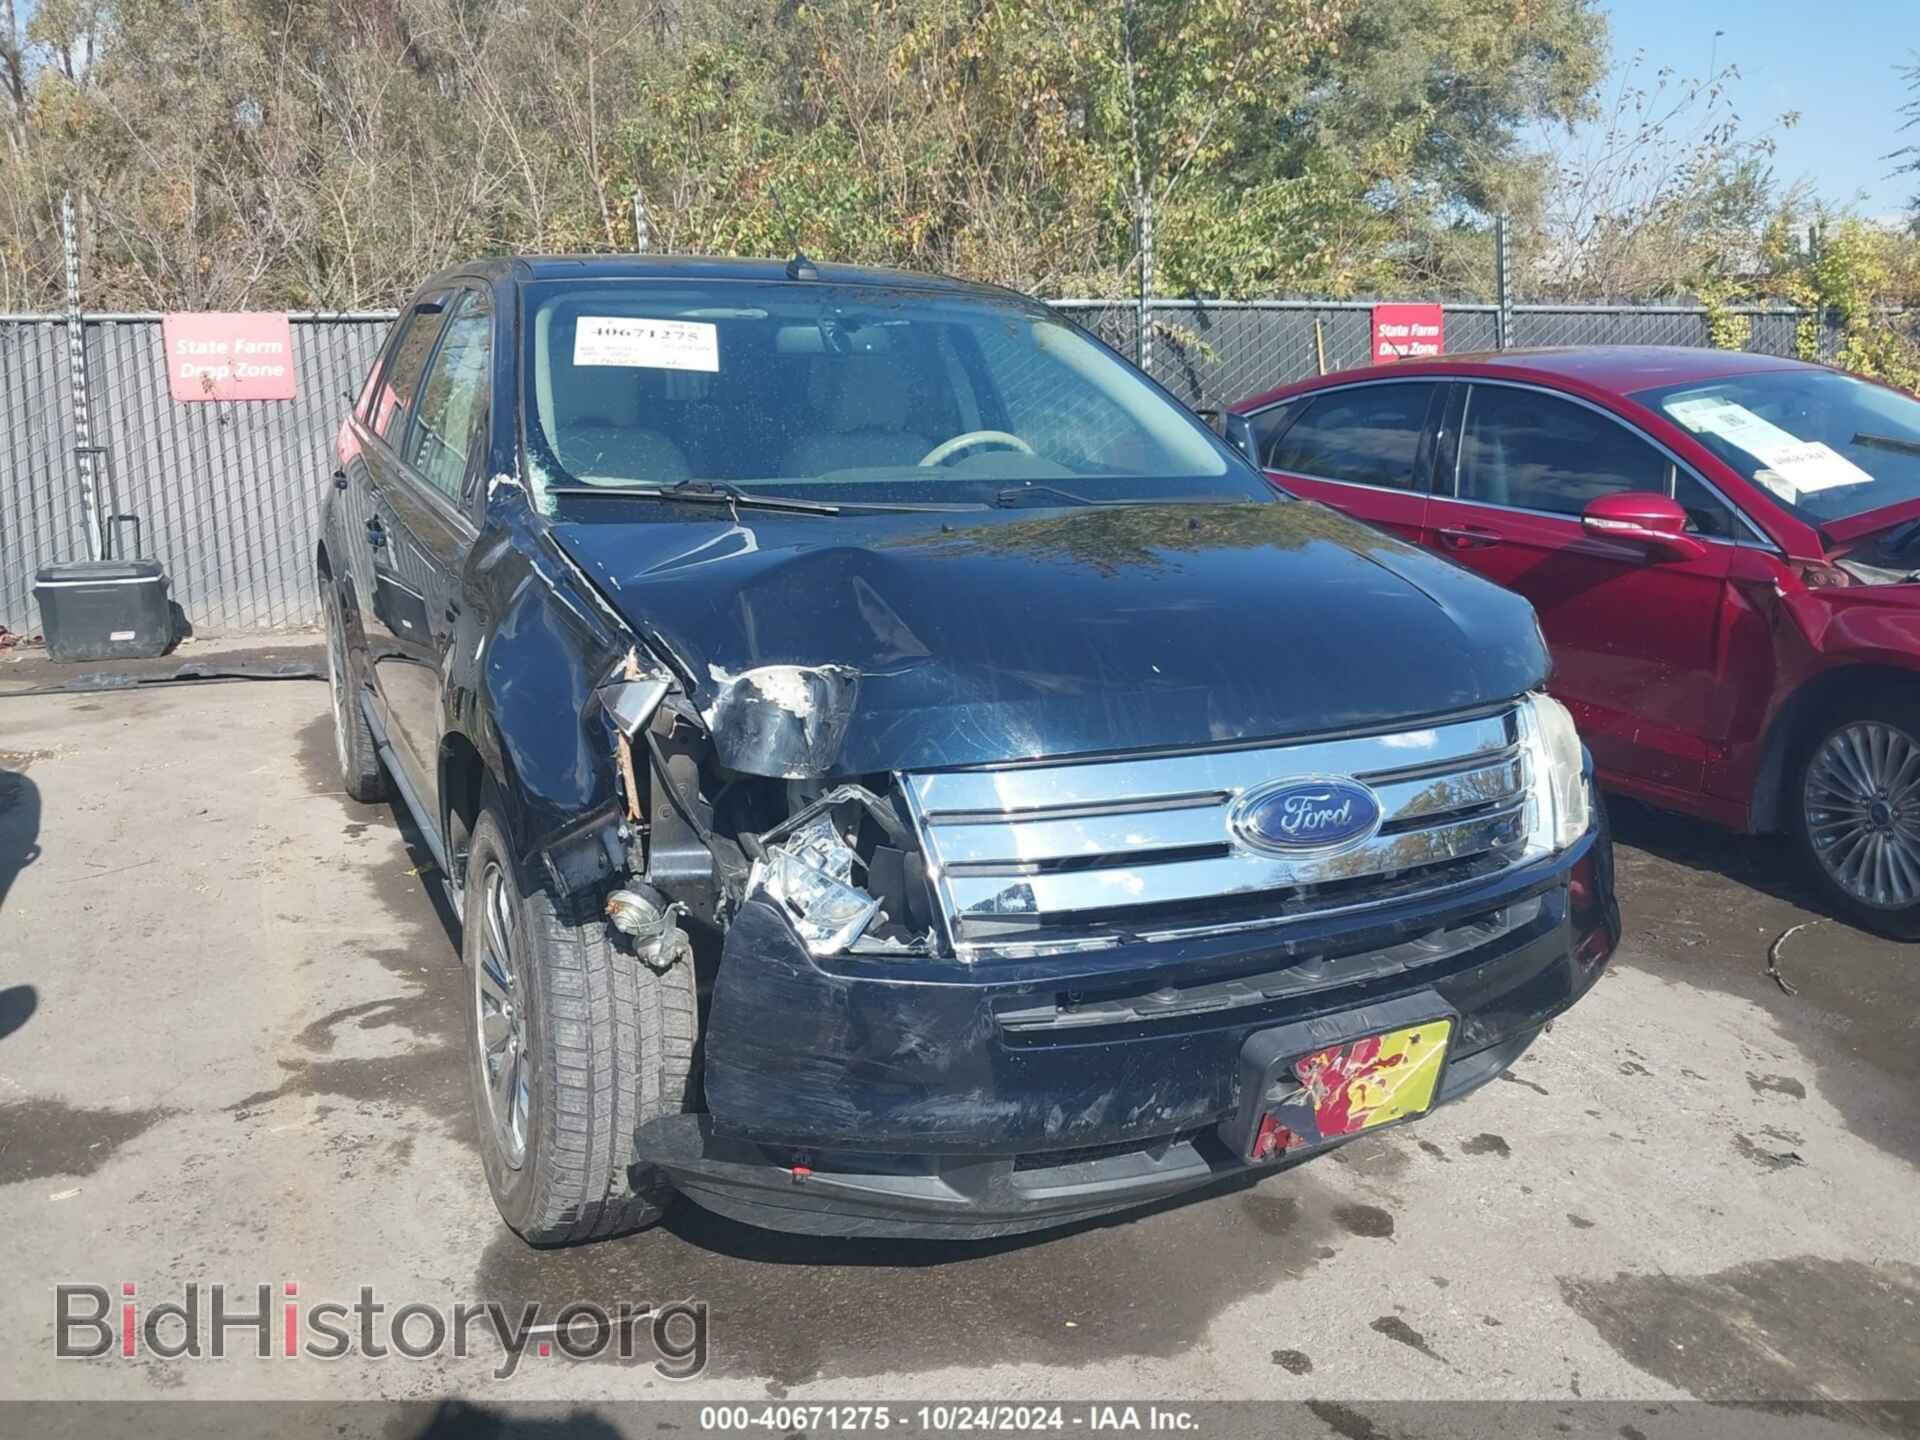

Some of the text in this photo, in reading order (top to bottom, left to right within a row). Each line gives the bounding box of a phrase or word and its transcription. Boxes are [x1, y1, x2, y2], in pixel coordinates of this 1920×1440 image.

[1378, 323, 1440, 337] State Farm
[174, 338, 284, 355] State Farm
[1410, 342, 1439, 356] Zone
[179, 362, 285, 379] Drop Zone
[1281, 794, 1352, 835] Ford
